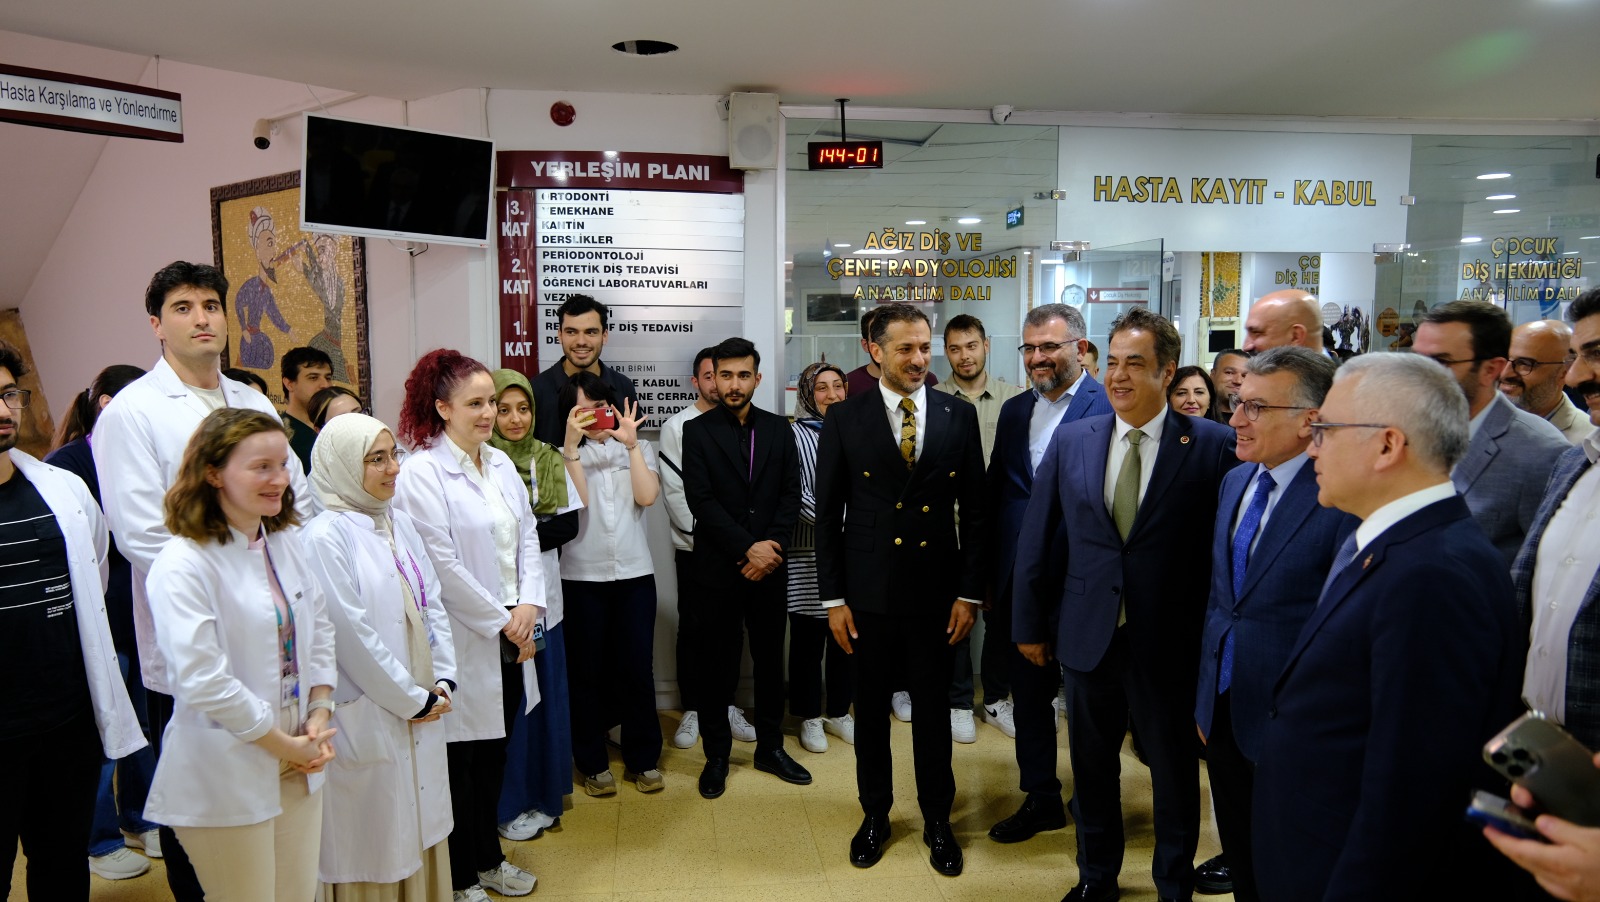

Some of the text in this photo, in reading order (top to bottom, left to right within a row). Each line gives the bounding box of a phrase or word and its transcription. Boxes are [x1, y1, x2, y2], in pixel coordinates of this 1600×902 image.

[0, 81, 177, 123] Hasta Karşılama ve Yönlendirme
[819, 147, 878, 163] 144-01
[530, 158, 710, 183] YERLEŞİM PLANI
[1093, 175, 1183, 203] HASTA
[1190, 177, 1268, 205] KAYIT
[1293, 179, 1377, 207] KABUL
[510, 200, 525, 216] 3.
[542, 206, 614, 216] EMEKHANE
[501, 222, 530, 237] KAT
[541, 218, 585, 230] KANTİN
[542, 233, 613, 244] DERSLİKLER
[864, 228, 982, 255] AĞIZ DİŞ VE
[542, 249, 644, 261] PERİODONTOLOJİ
[1490, 236, 1558, 259] ÇOCUK
[511, 258, 526, 273] 2.
[543, 262, 679, 277] PROTETİK DİŞ TEDAVİSİ
[826, 255, 1017, 280] ÇENE RADYOLOJİSİ
[1462, 257, 1582, 283] DİŞ HEKİMLİĞİ
[543, 276, 708, 290] ÖĞRENCİ LABORATUVARLARI
[1275, 268, 1298, 287] DİŞ
[503, 279, 531, 294] KAT
[853, 282, 992, 301] ANABİLİM DALI
[1459, 283, 1580, 301] ANABİLİM DALI
[513, 320, 528, 336] 1.
[618, 321, 639, 335] DİŞ
[642, 321, 693, 333] TEDAVİSİ
[505, 341, 533, 357] KAT
[643, 378, 681, 388] KABUL
